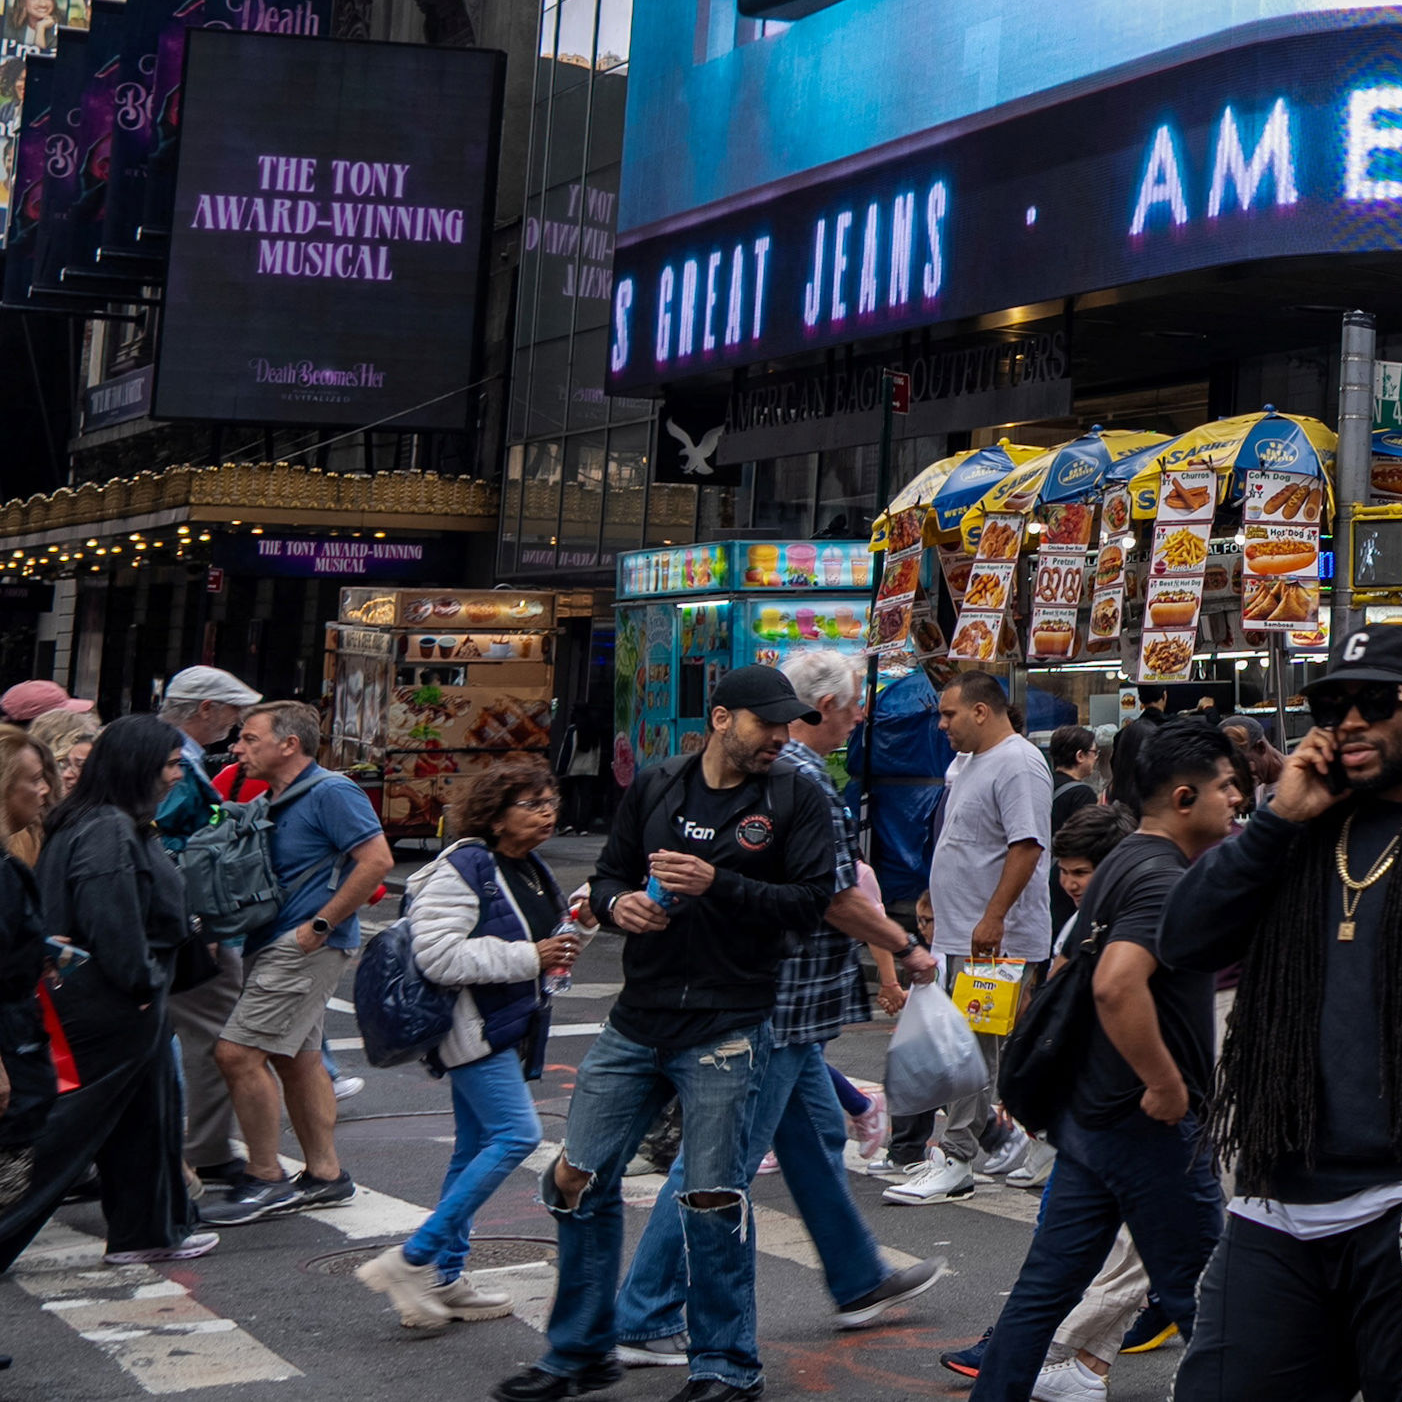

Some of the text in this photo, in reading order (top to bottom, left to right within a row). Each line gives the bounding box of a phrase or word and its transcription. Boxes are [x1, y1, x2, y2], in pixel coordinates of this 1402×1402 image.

[258, 155, 410, 198] THE TONY
[190, 194, 464, 243] AWARD-WINNING
[257, 239, 393, 280] MUSICAL
[655, 235, 770, 362] GREAT
[803, 181, 947, 327] JEANS
[249, 357, 387, 388] Death Becomes Her
[724, 376, 832, 435] AMERICAN
[911, 330, 1066, 400] OUTFITTERS
[1248, 471, 1291, 482] Corn Dog
[1270, 528, 1285, 537] Hot
[1288, 528, 1304, 538] Dog
[258, 540, 423, 560] THE TONY AWARD-WINNING
[1052, 557, 1076, 566] Pretzel
[314, 557, 366, 573] MUSICAL
[1191, 579, 1201, 587] Dog
[1342, 632, 1370, 662] G
[684, 821, 716, 841] Fan
